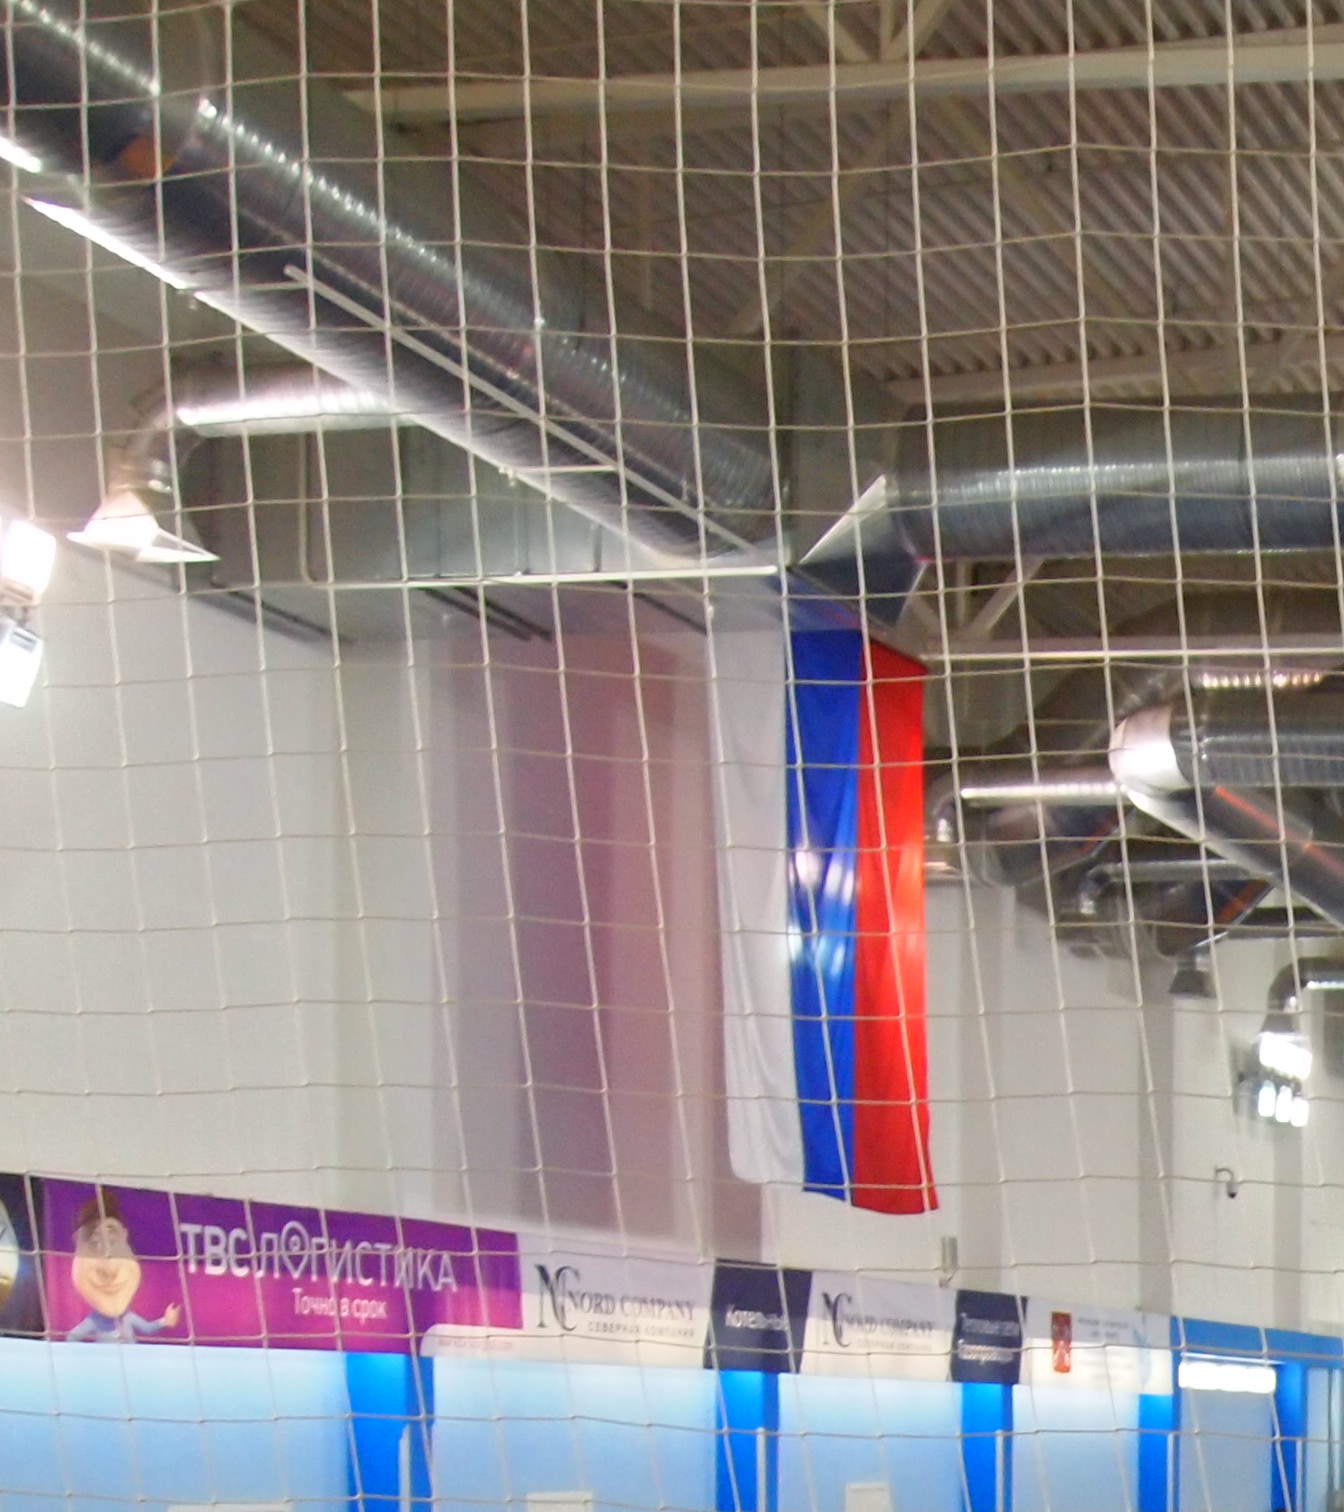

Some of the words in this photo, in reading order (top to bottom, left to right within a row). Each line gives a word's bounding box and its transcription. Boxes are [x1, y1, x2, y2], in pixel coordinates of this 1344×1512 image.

[292, 1287, 336, 1317] Точно
[352, 1297, 388, 1325] срок
[568, 1289, 616, 1316] NORD
[620, 1294, 696, 1322] COMPANY
